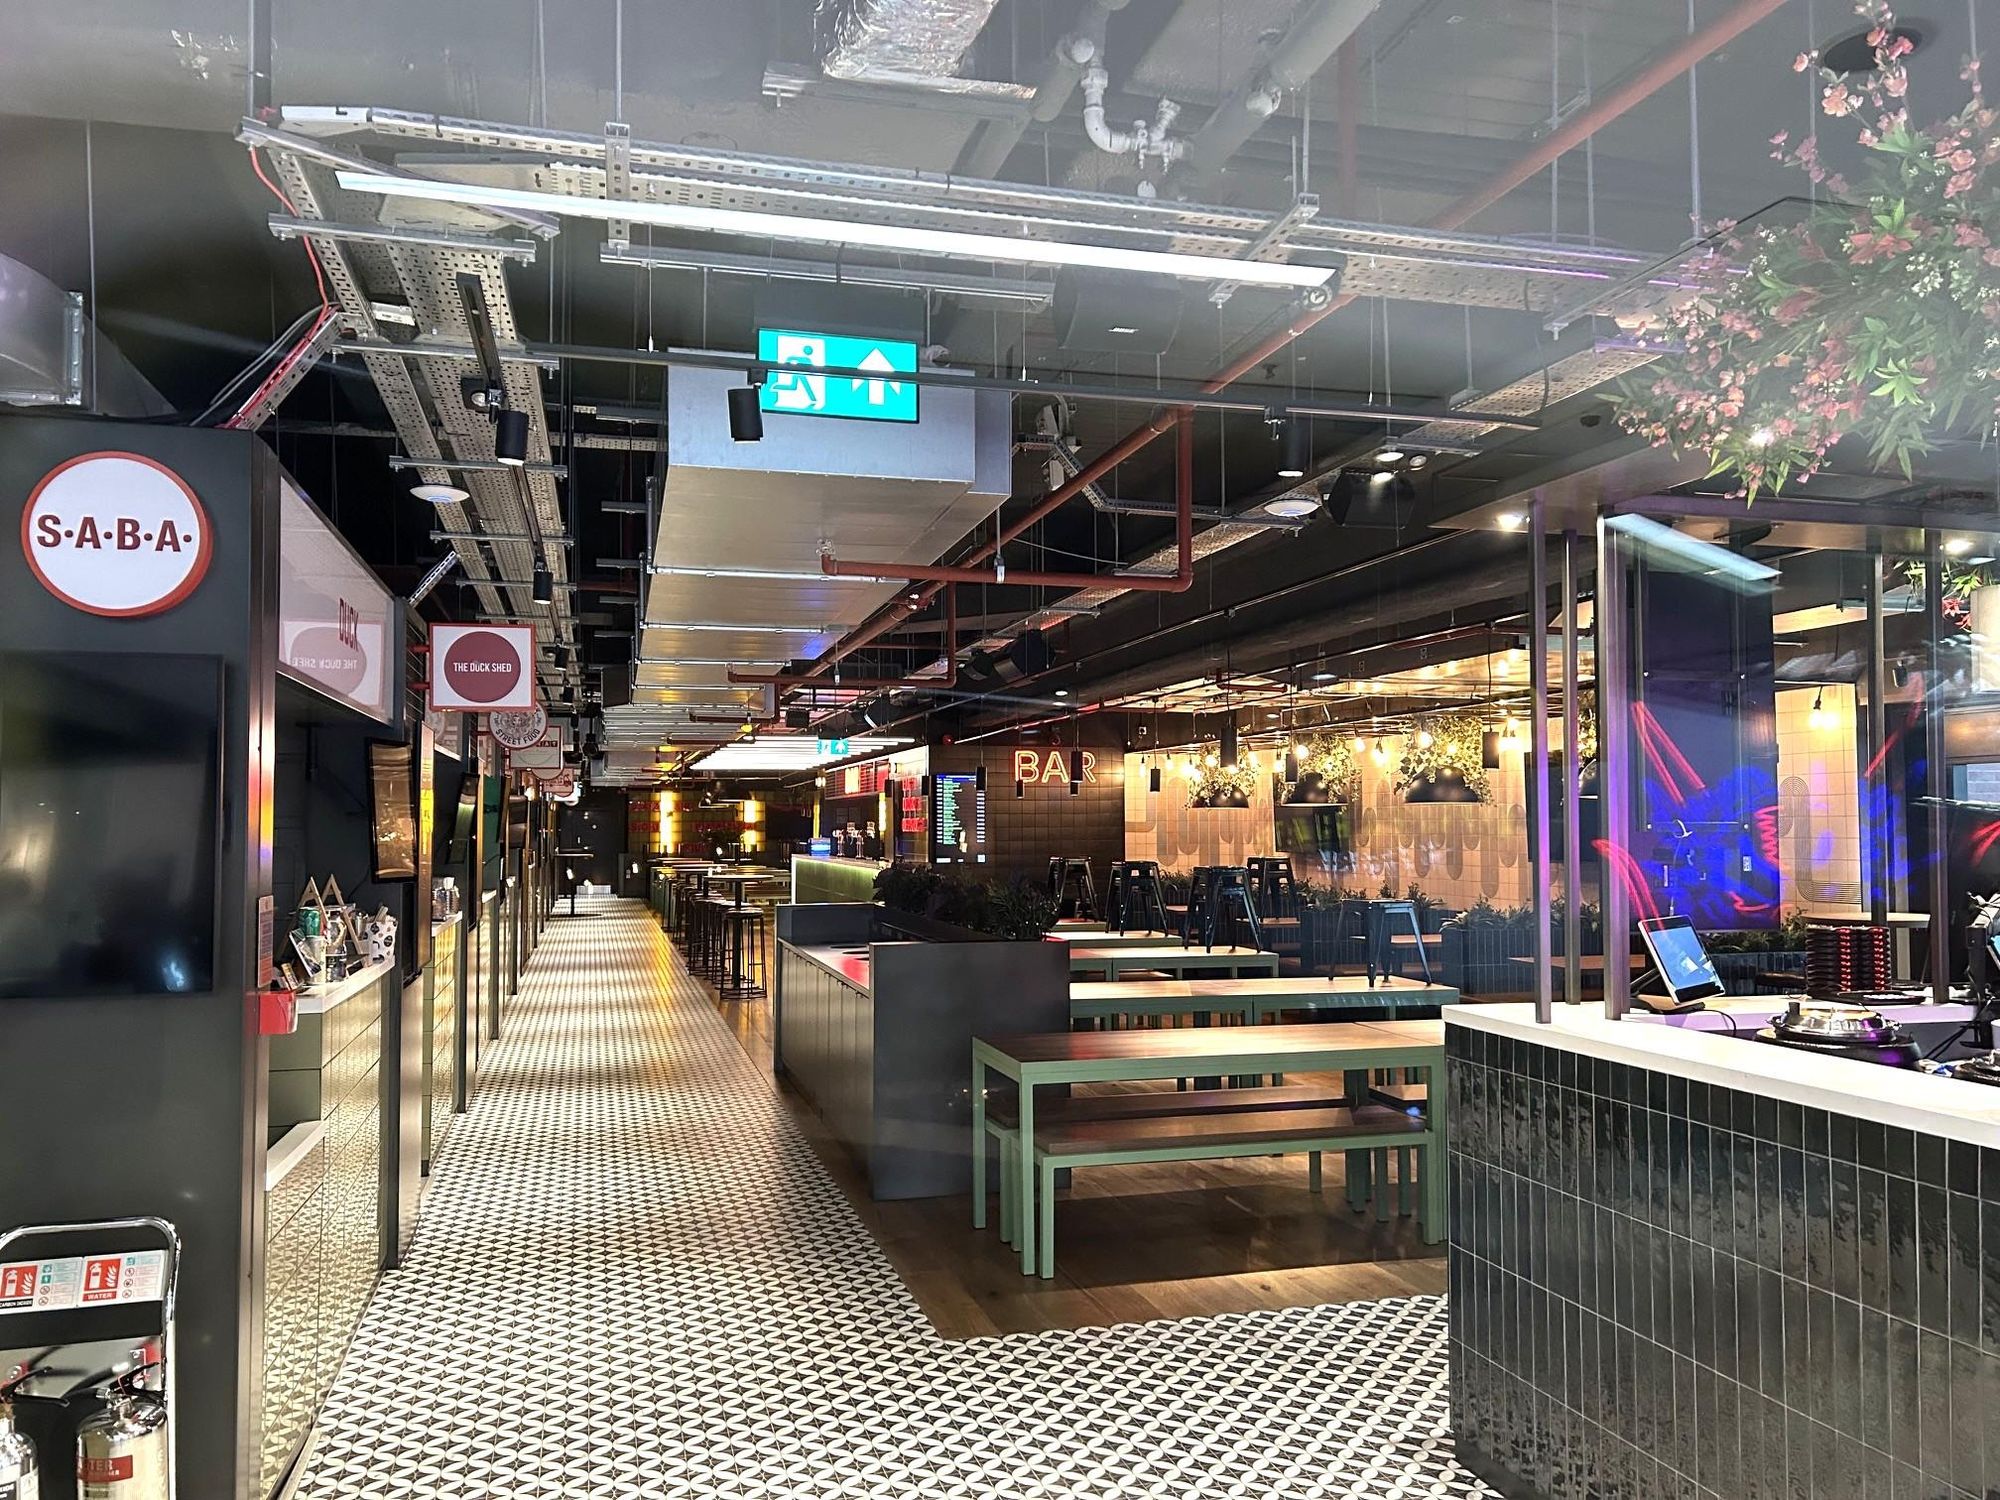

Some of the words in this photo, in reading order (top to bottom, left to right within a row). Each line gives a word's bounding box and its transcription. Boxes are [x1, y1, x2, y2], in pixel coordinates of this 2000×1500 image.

[339, 597, 359, 652] DUCK
[453, 662, 468, 672] THE
[469, 662, 490, 673] DUCK
[491, 662, 512, 673] SHED
[495, 728, 521, 745] STREET
[524, 728, 540, 744] FOOD
[1014, 750, 1097, 783] BAR
[87, 1293, 113, 1301] WATER
